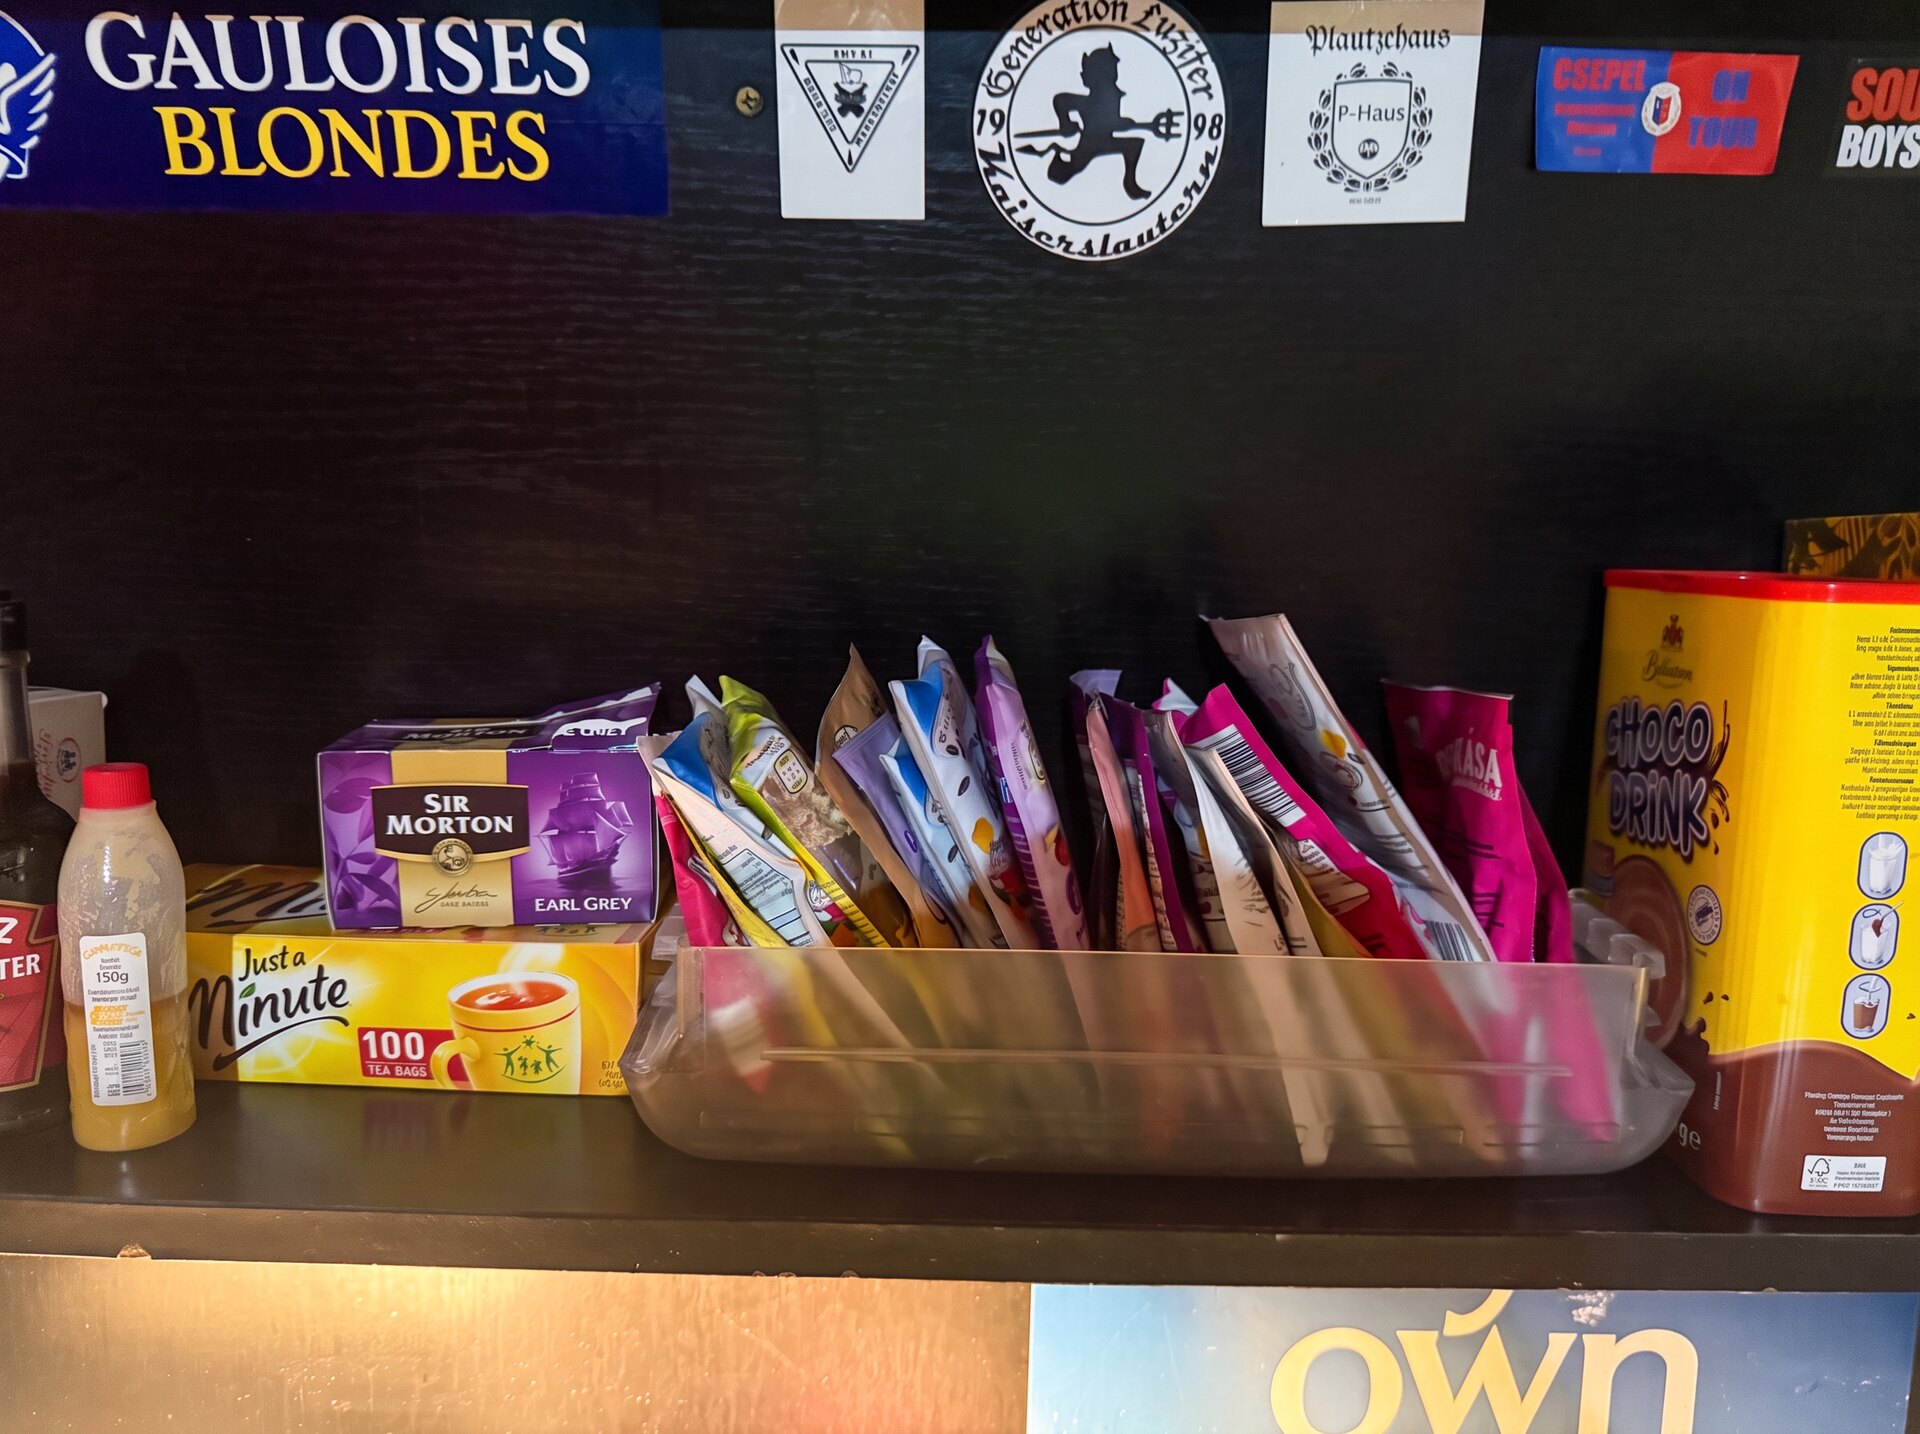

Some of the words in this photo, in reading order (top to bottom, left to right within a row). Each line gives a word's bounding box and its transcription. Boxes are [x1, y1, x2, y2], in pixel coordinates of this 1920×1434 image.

[84, 11, 591, 97] GAULOISES
[981, 0, 1128, 99] Generation
[1130, 3, 1214, 101] Luziter
[1711, 69, 1751, 102] ON
[976, 108, 1006, 136] 19
[1193, 113, 1224, 141] 98
[1338, 104, 1406, 123] P-Haus
[153, 106, 550, 182] BLONDES
[1688, 116, 1759, 149] TOUR
[1836, 124, 1920, 169] BOYS
[1605, 696, 1713, 769] CHOCO
[423, 793, 471, 814] SIR
[385, 814, 514, 836] MORTON
[535, 898, 581, 912] EARL
[583, 896, 633, 912] GREY
[96, 971, 130, 985] 150g
[243, 945, 287, 981] Just
[292, 950, 307, 967] a
[188, 963, 350, 1049] Minute
[361, 1030, 426, 1061] 100
[367, 1064, 392, 1078] TEA
[397, 1064, 428, 1078] BAGS
[1270, 1324, 1700, 1434] own
